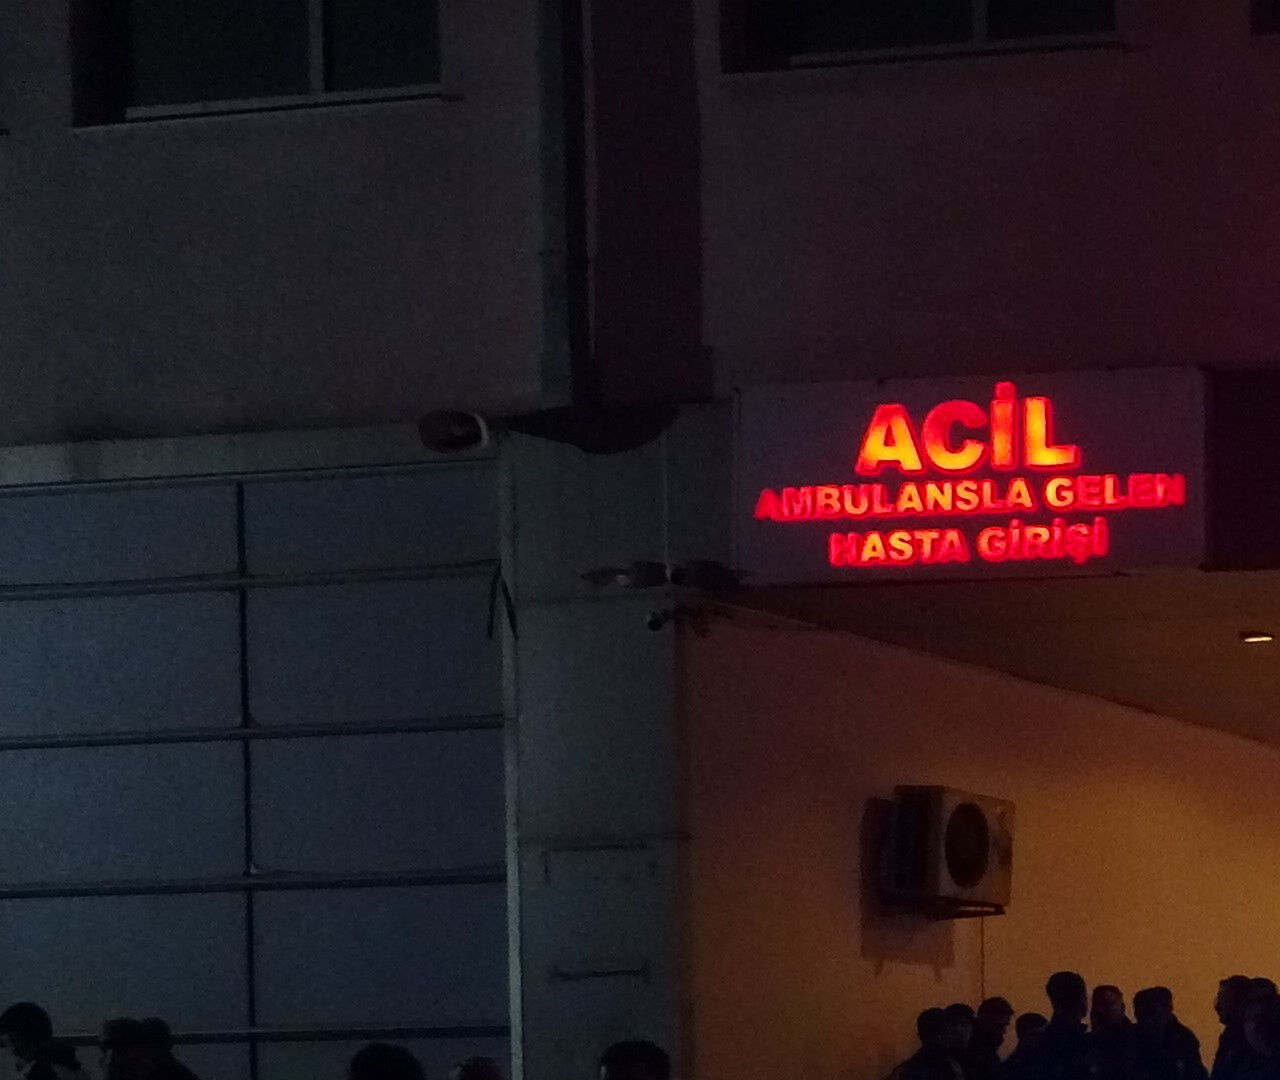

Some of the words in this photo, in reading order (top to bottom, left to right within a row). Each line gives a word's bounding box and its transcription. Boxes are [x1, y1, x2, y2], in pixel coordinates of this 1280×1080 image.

[855, 381, 1080, 474] ACİL
[754, 479, 1033, 521] AMBULANSLA
[1045, 474, 1186, 512] GELEN
[829, 528, 970, 567] HASTA
[977, 516, 1109, 564] GİRİŞİ
